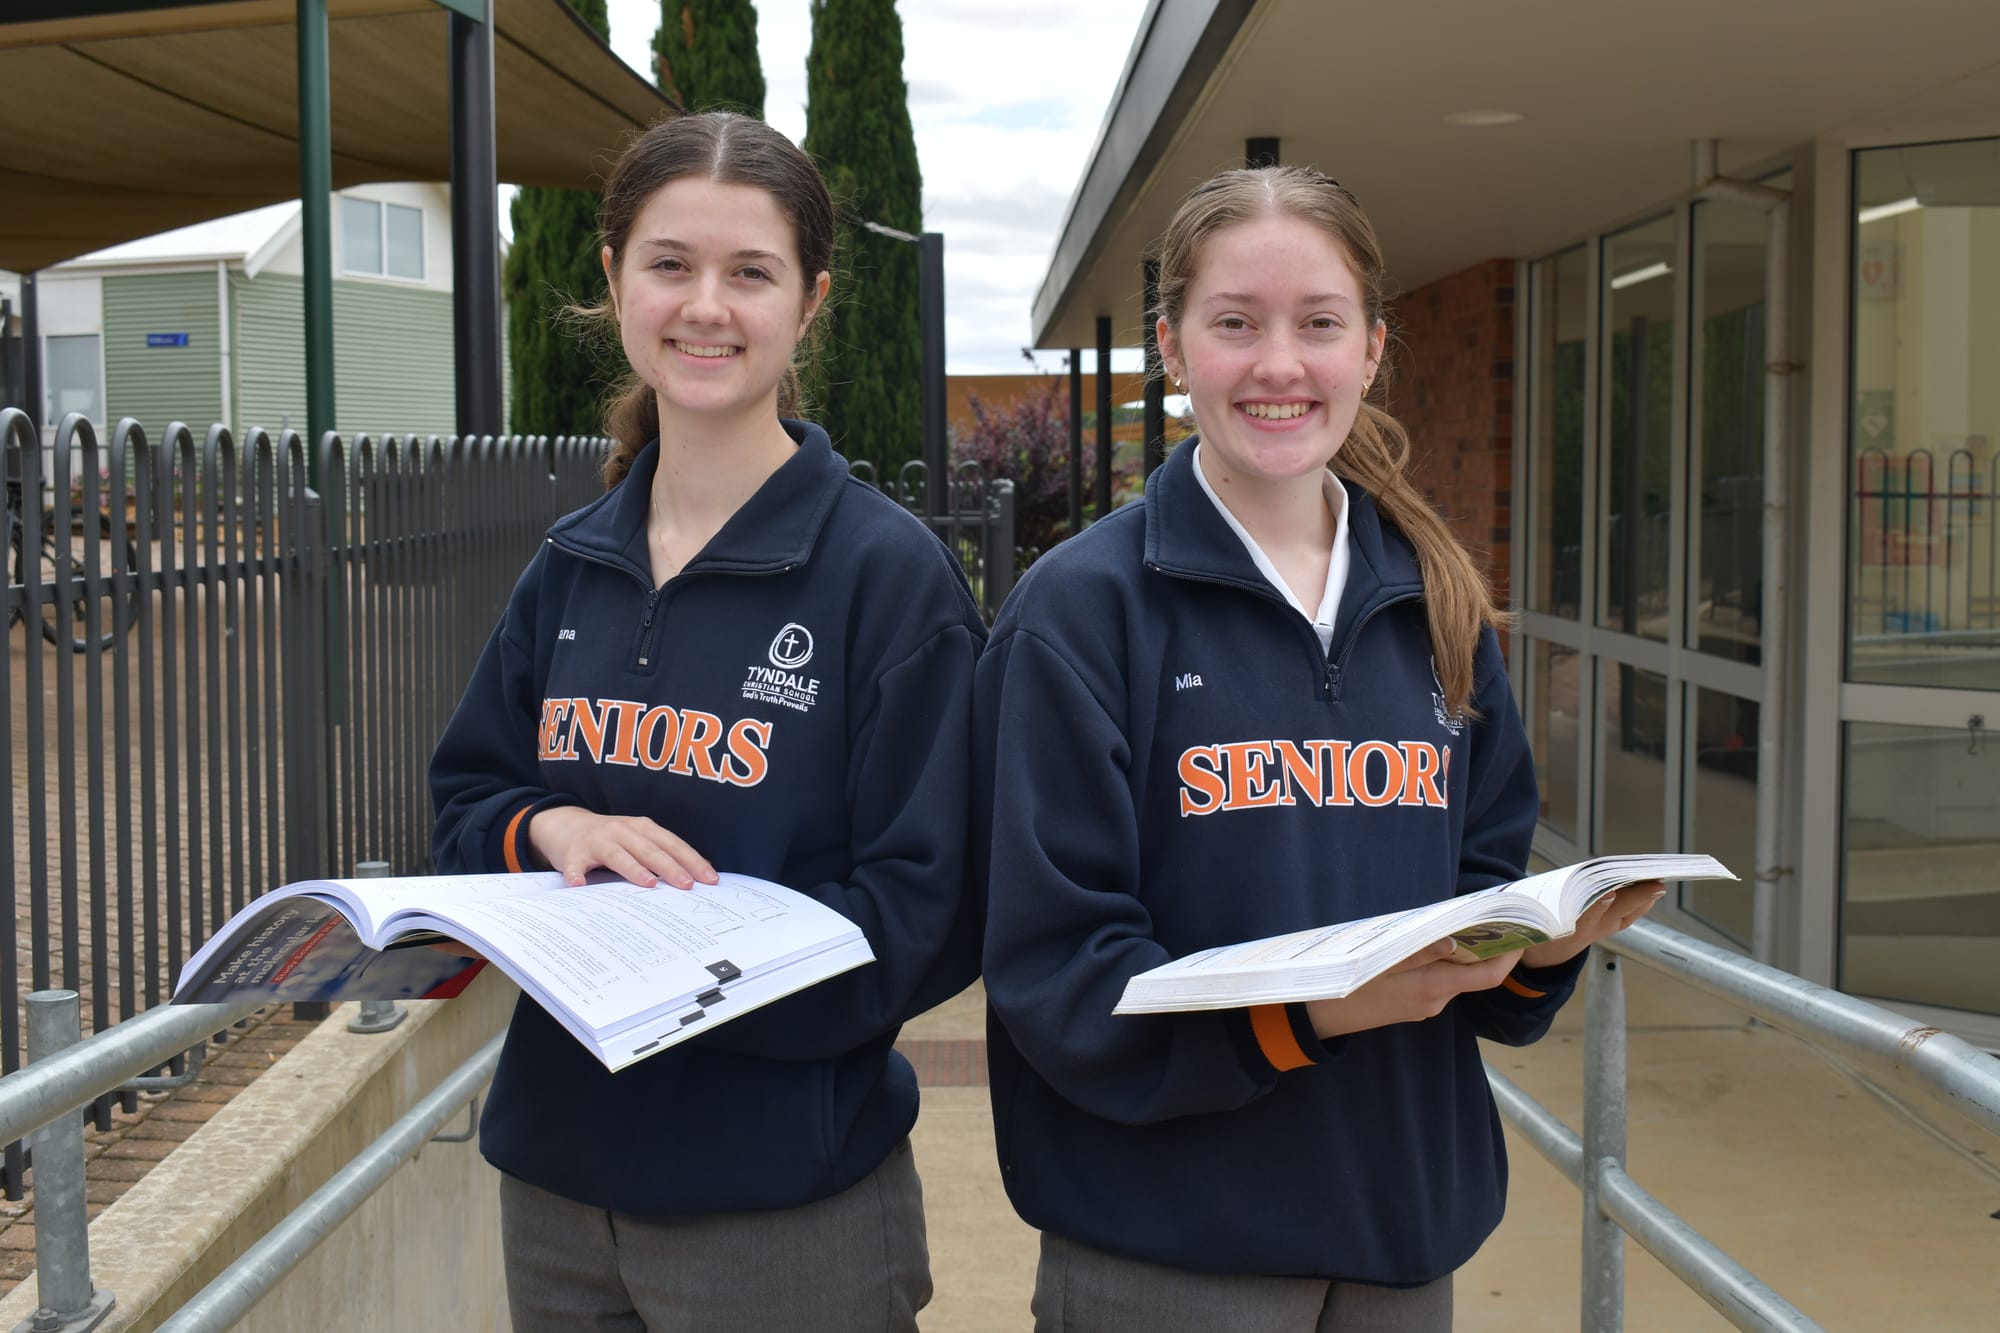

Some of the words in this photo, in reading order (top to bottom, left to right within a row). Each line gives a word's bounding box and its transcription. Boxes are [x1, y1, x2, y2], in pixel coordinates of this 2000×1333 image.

[743, 681, 781, 693] CHRISTIAN
[783, 687, 816, 703] SCHOOL
[748, 666, 820, 695] TYNDALE
[1176, 672, 1203, 691] Mia
[760, 692, 778, 705] Truth
[779, 696, 808, 712] Prevails
[213, 949, 252, 984] Make
[247, 908, 299, 948] history
[250, 926, 311, 984] molecular
[235, 970, 251, 984] at
[247, 946, 273, 968] the
